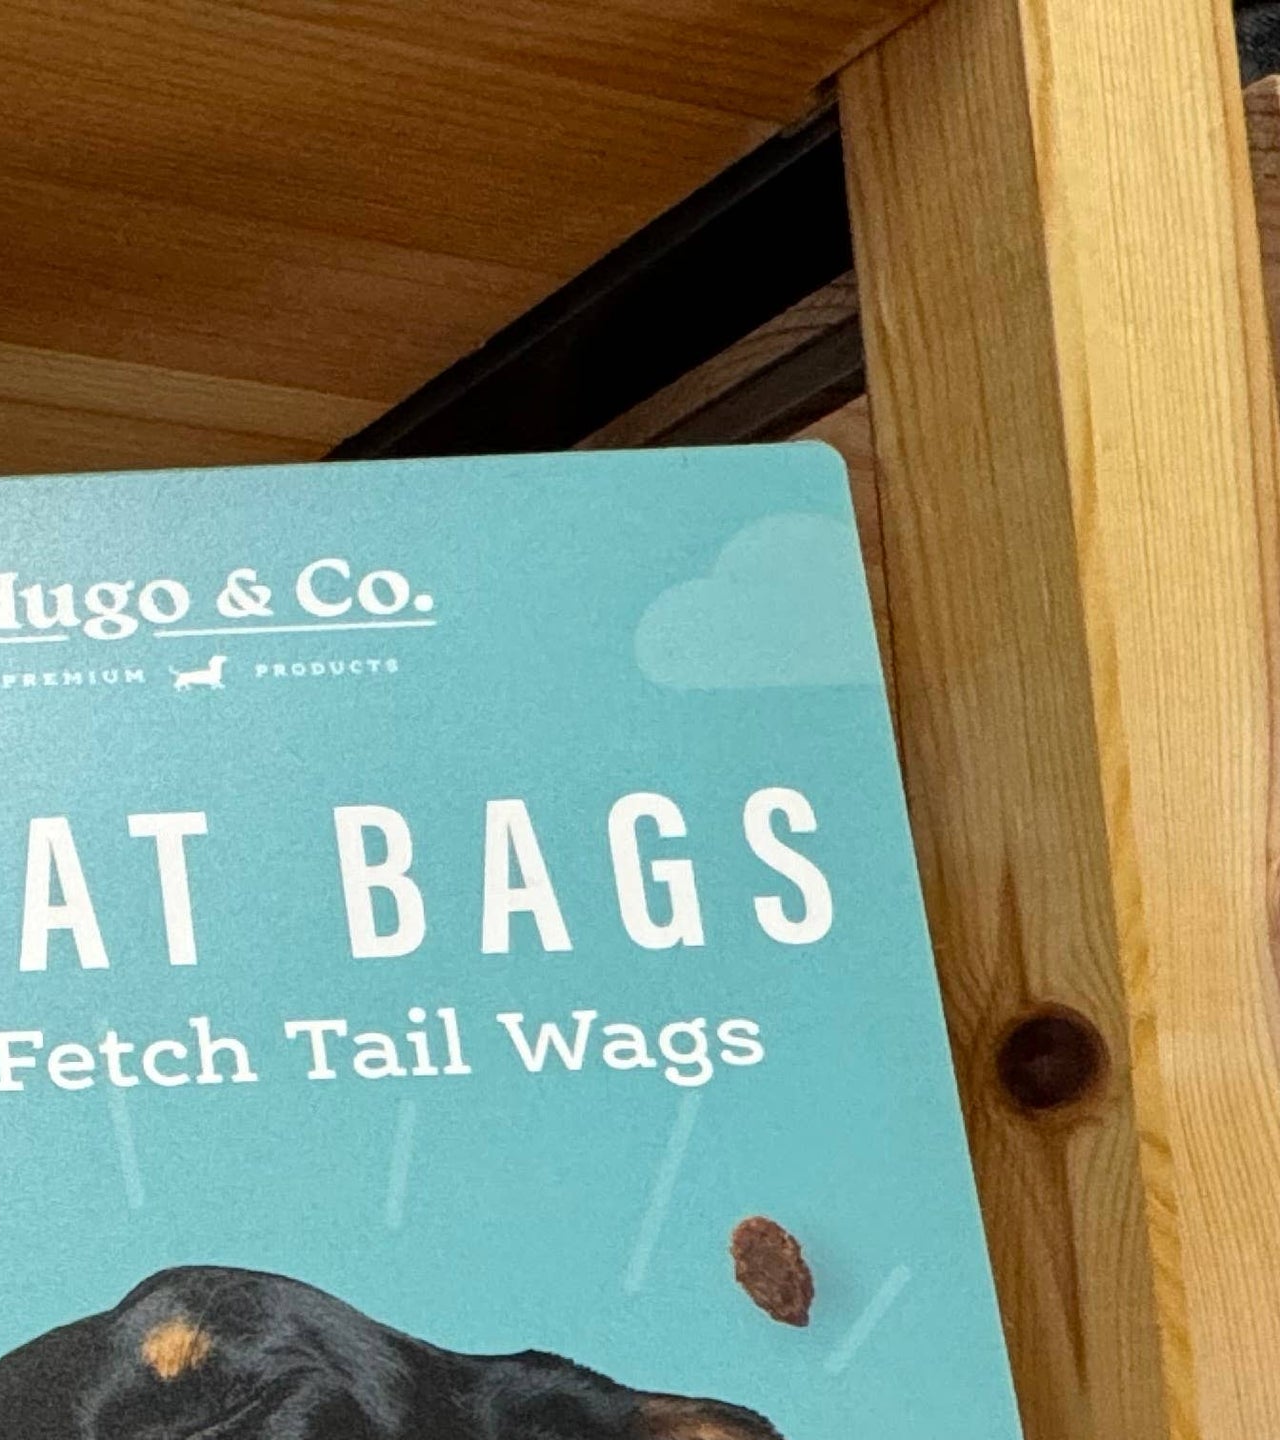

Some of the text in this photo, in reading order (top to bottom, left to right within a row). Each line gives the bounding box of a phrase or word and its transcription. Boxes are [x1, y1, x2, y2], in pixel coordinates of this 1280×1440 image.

[216, 567, 274, 619] &
[295, 558, 434, 618] Co.
[0, 658, 400, 689] PREMIUM PRODUCTS
[333, 786, 834, 959] BAGS
[284, 1006, 472, 1080] Tail
[495, 1009, 765, 1087] Wags
